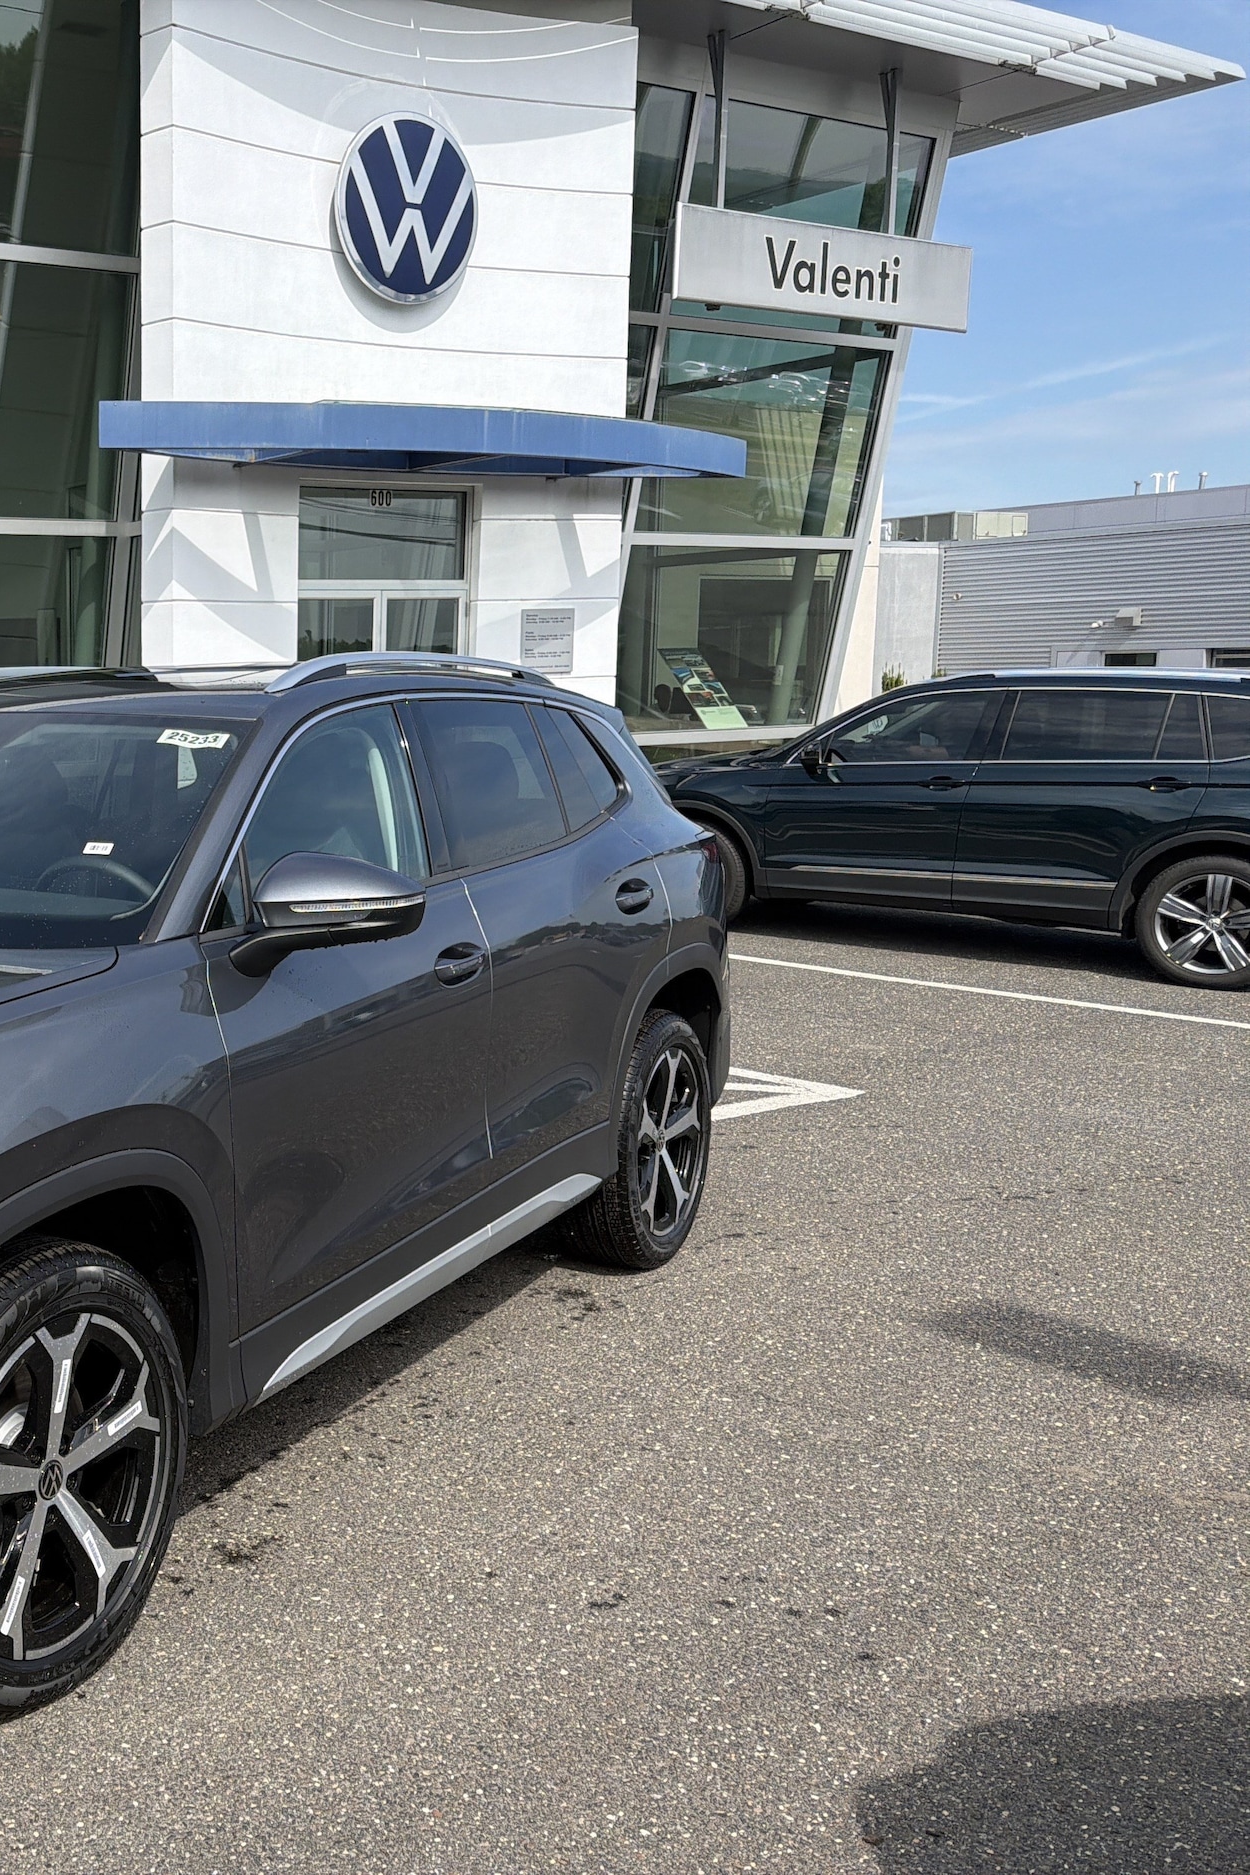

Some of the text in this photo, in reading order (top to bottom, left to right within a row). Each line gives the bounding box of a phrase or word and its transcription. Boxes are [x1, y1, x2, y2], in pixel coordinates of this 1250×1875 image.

[764, 235, 901, 304] Valenti
[370, 490, 392, 506] 600
[166, 731, 220, 745] 25233
